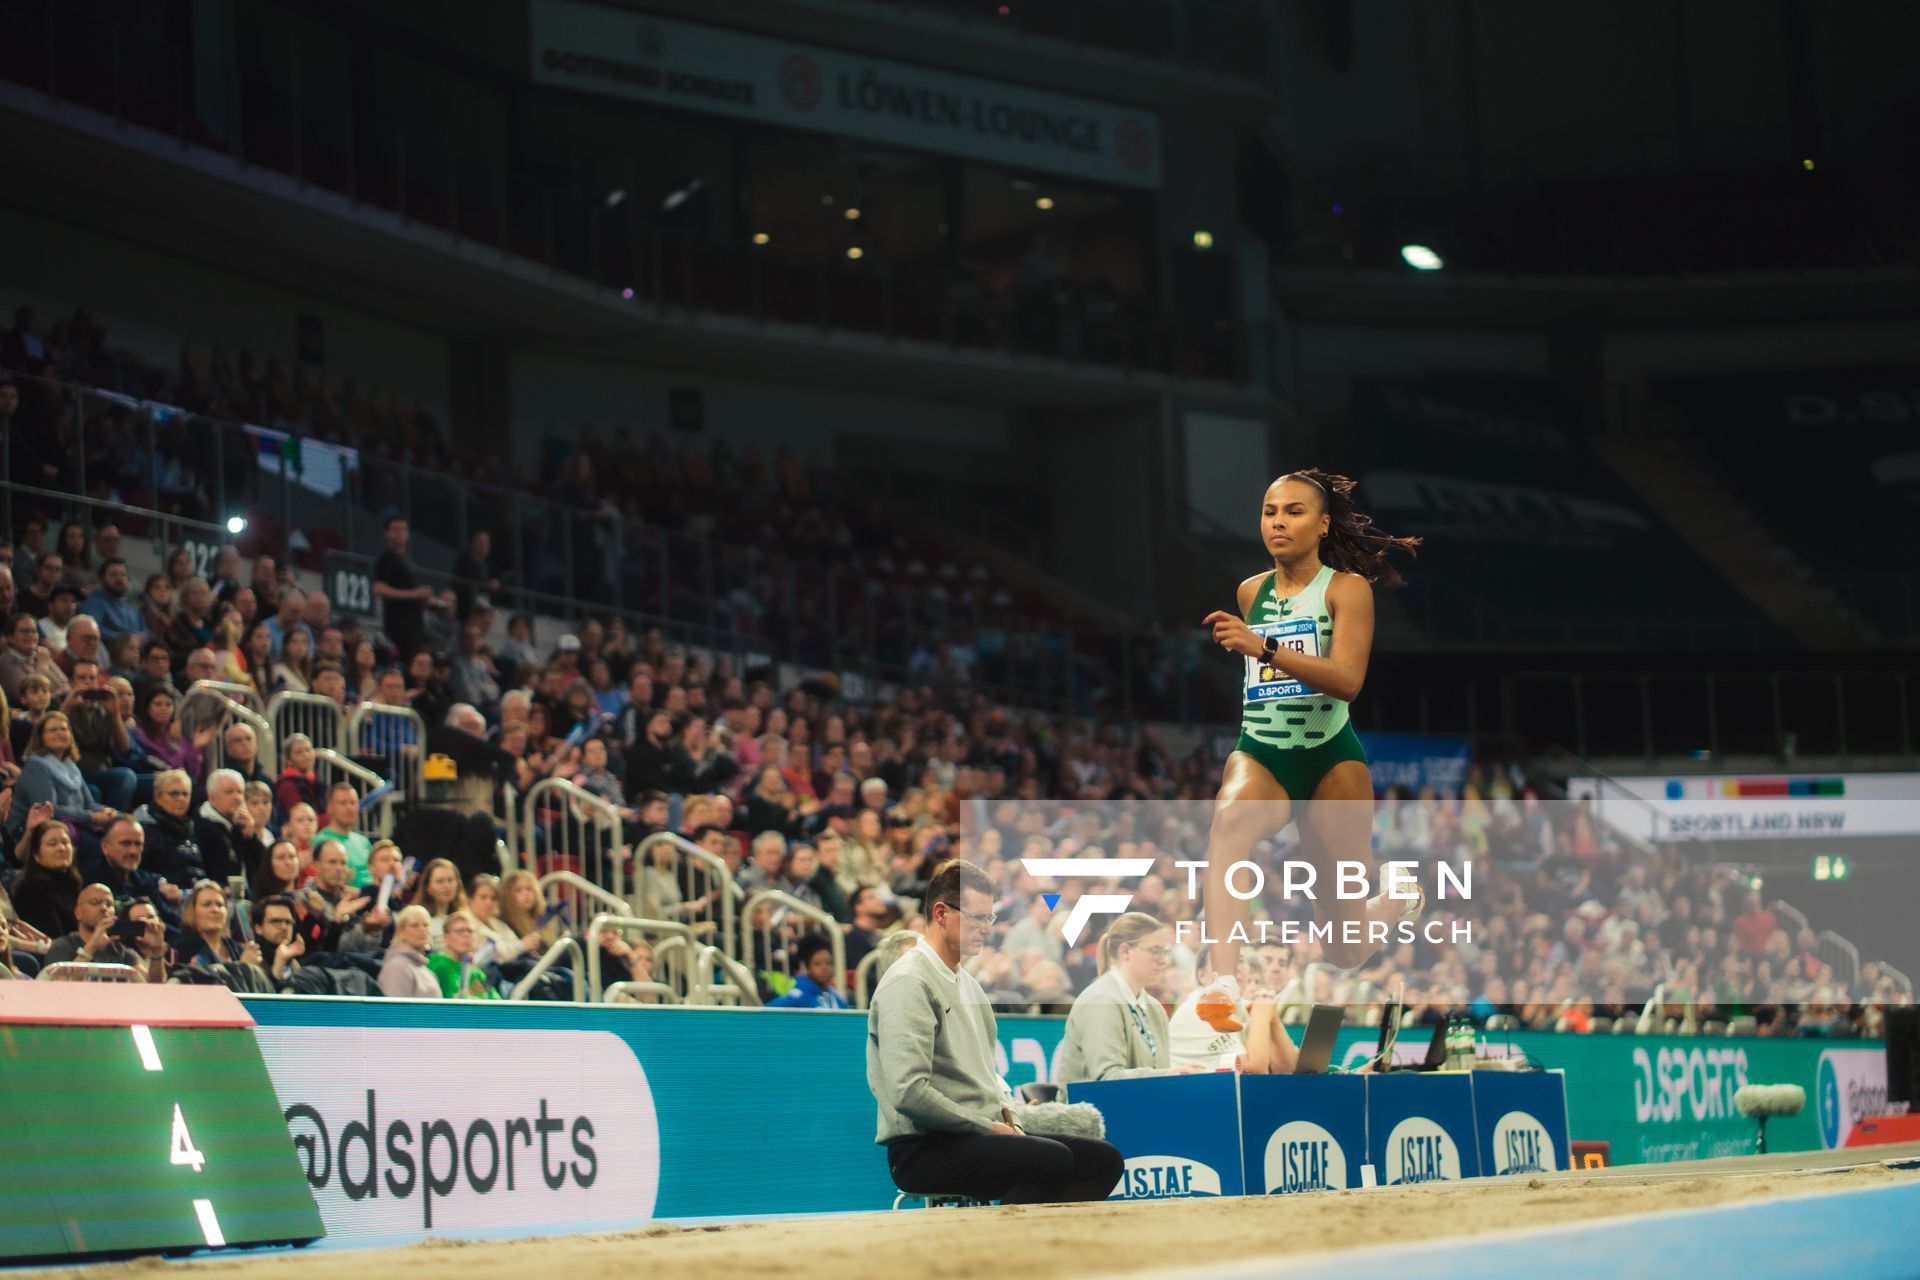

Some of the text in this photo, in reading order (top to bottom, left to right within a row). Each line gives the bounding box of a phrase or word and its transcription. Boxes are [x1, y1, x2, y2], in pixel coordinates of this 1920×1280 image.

[837, 68, 1102, 156] LÖWEN-LOUNGE
[336, 570, 371, 610] 023
[1258, 684, 1303, 697] D.SPORTS
[1670, 811, 1847, 833] SPORTLAND.NRW
[1633, 1046, 1750, 1123] D.SPORTS
[170, 1103, 206, 1172] 4
[284, 1088, 599, 1229] @dsports
[1400, 1135, 1443, 1185] ISTAF
[1505, 1128, 1541, 1175] ISTAF
[1124, 1164, 1193, 1198] ISTAF
[1281, 1140, 1329, 1194] ISTAF
